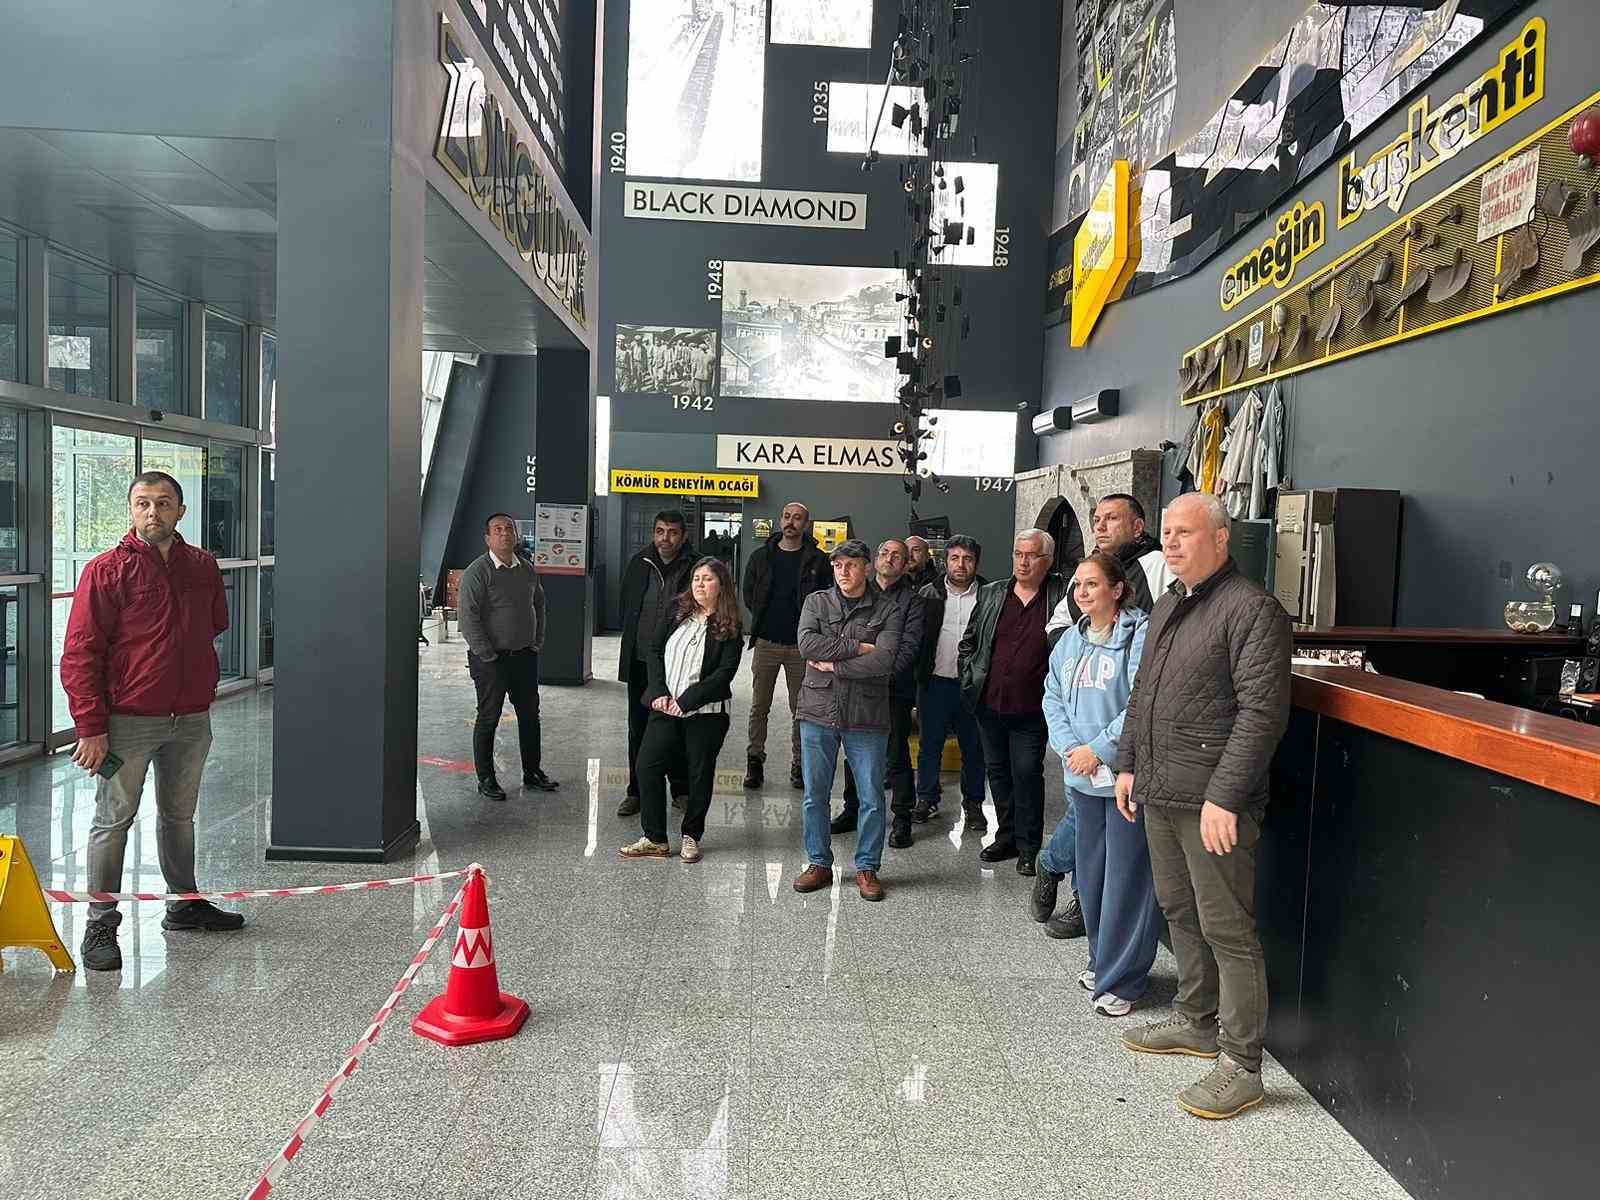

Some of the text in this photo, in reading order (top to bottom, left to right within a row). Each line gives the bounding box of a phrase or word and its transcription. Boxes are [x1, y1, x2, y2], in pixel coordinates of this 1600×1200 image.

[813, 81, 829, 124] 1935
[1341, 29, 1538, 220] başkenti
[610, 131, 626, 173] 1940
[633, 189, 857, 223] BLACK DIAMOND
[995, 226, 1009, 267] 1948
[1221, 206, 1321, 302] emeğin
[708, 259, 722, 301] 1948
[672, 395, 714, 411] 1942
[736, 441, 894, 470] KARA ELMAS
[616, 473, 754, 492] KÖMÜR DENEYİM OCAĞI
[974, 477, 1014, 492] 1947
[1062, 655, 1115, 690] GAP
